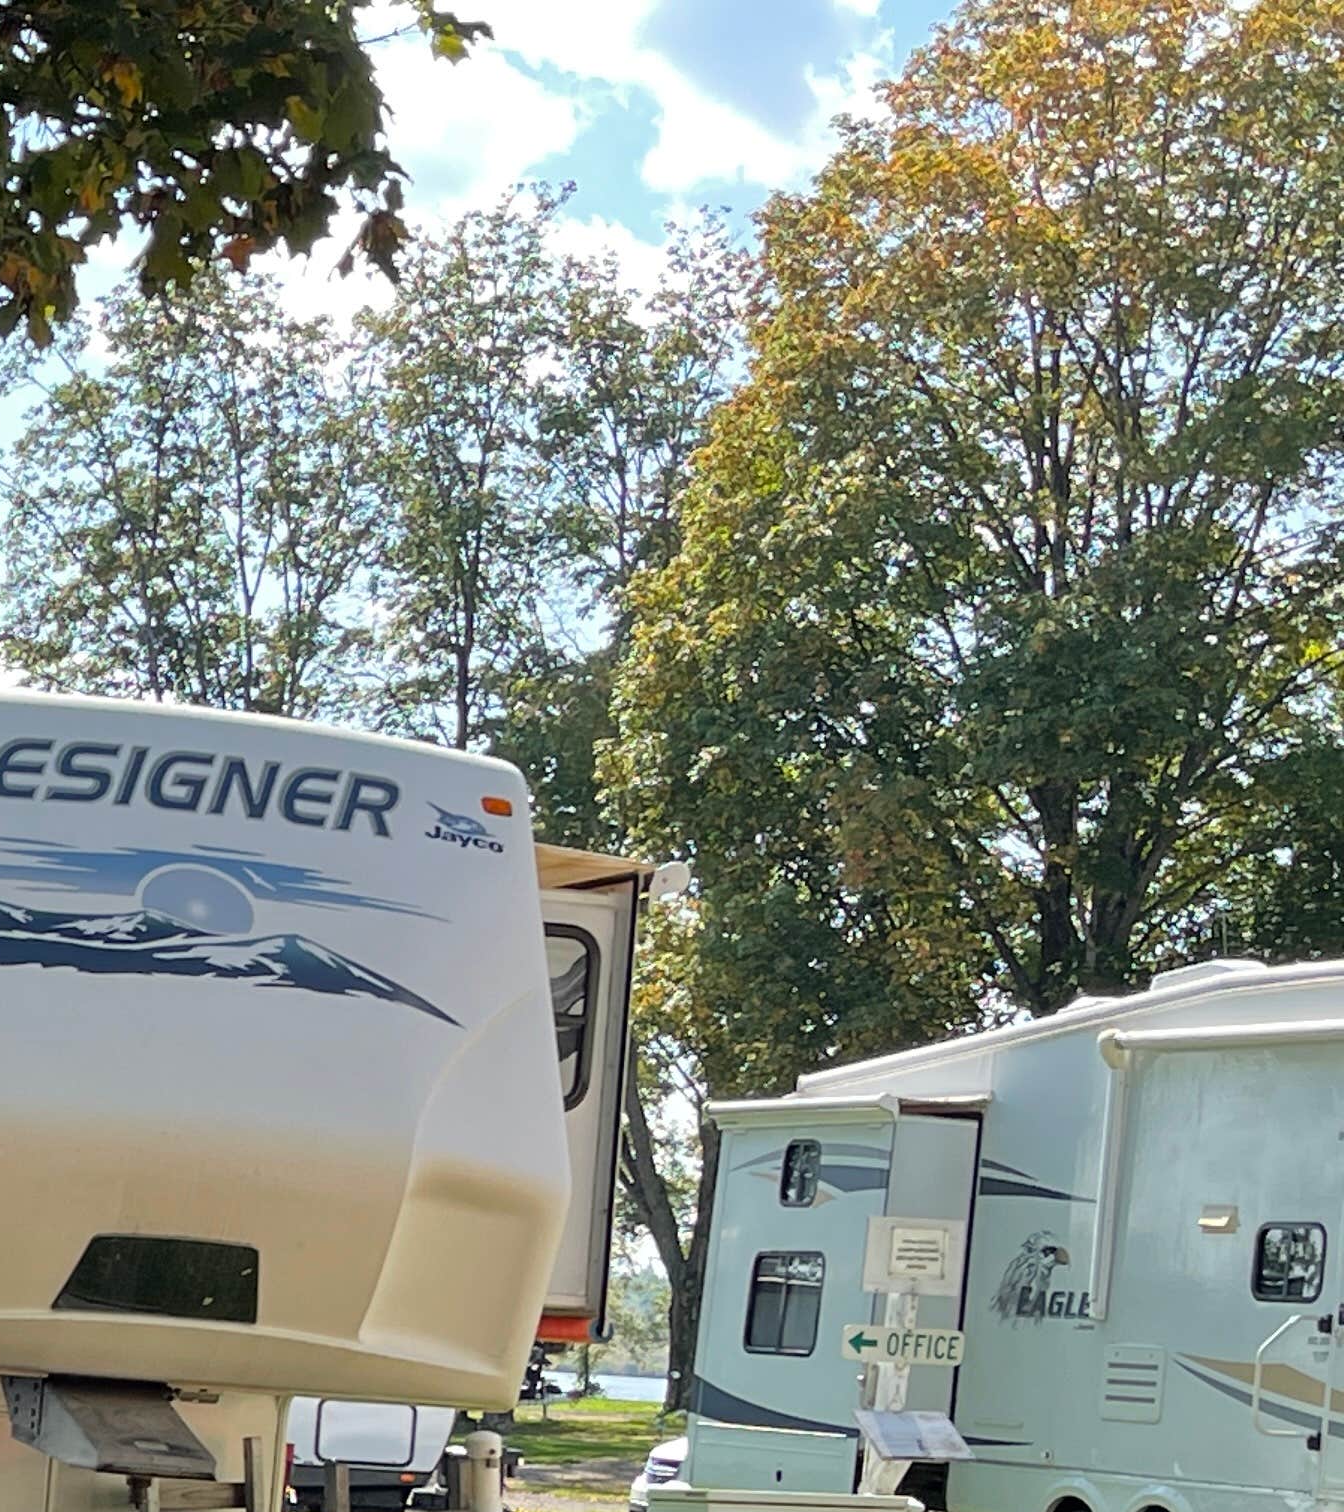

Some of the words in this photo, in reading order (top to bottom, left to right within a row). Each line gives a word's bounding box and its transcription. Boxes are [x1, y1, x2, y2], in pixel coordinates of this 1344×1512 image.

[425, 826, 504, 853] Jayco
[1016, 1286, 1090, 1318] EAGLE
[886, 1332, 960, 1360] OFFICE
